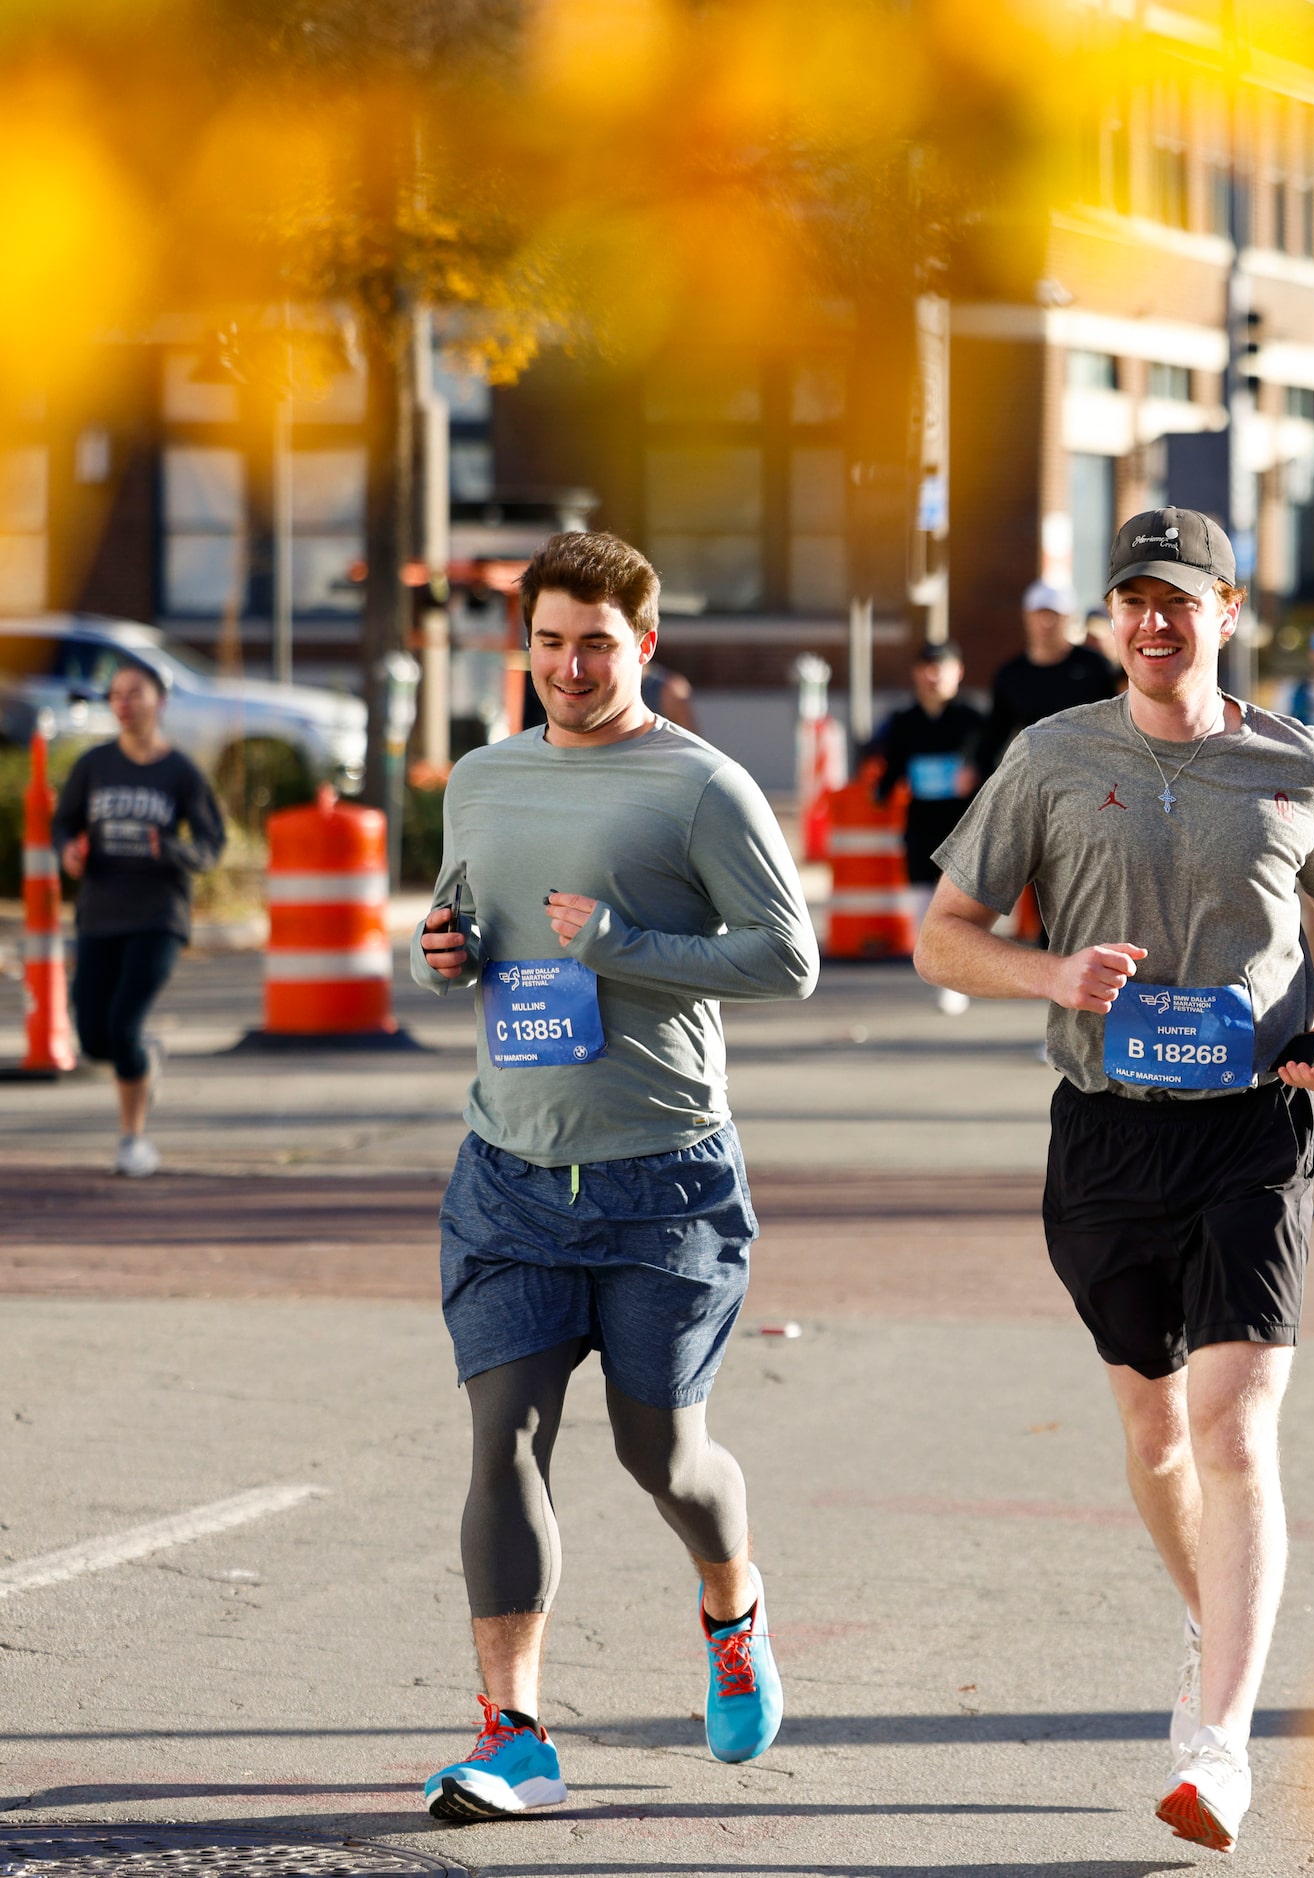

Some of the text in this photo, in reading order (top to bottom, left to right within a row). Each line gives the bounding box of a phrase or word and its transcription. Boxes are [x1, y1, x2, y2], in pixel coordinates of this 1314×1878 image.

[535, 967, 560, 975] DALLAS
[512, 1001, 546, 1012] MULLINS
[1173, 1001, 1212, 1009] MARATHON
[496, 1018, 574, 1042] C 13851
[1157, 1026, 1197, 1036] HUNTER
[1128, 1038, 1228, 1064] B 18268
[504, 1053, 538, 1062] MARATHON
[1115, 1067, 1182, 1083] HALF MARATHON
